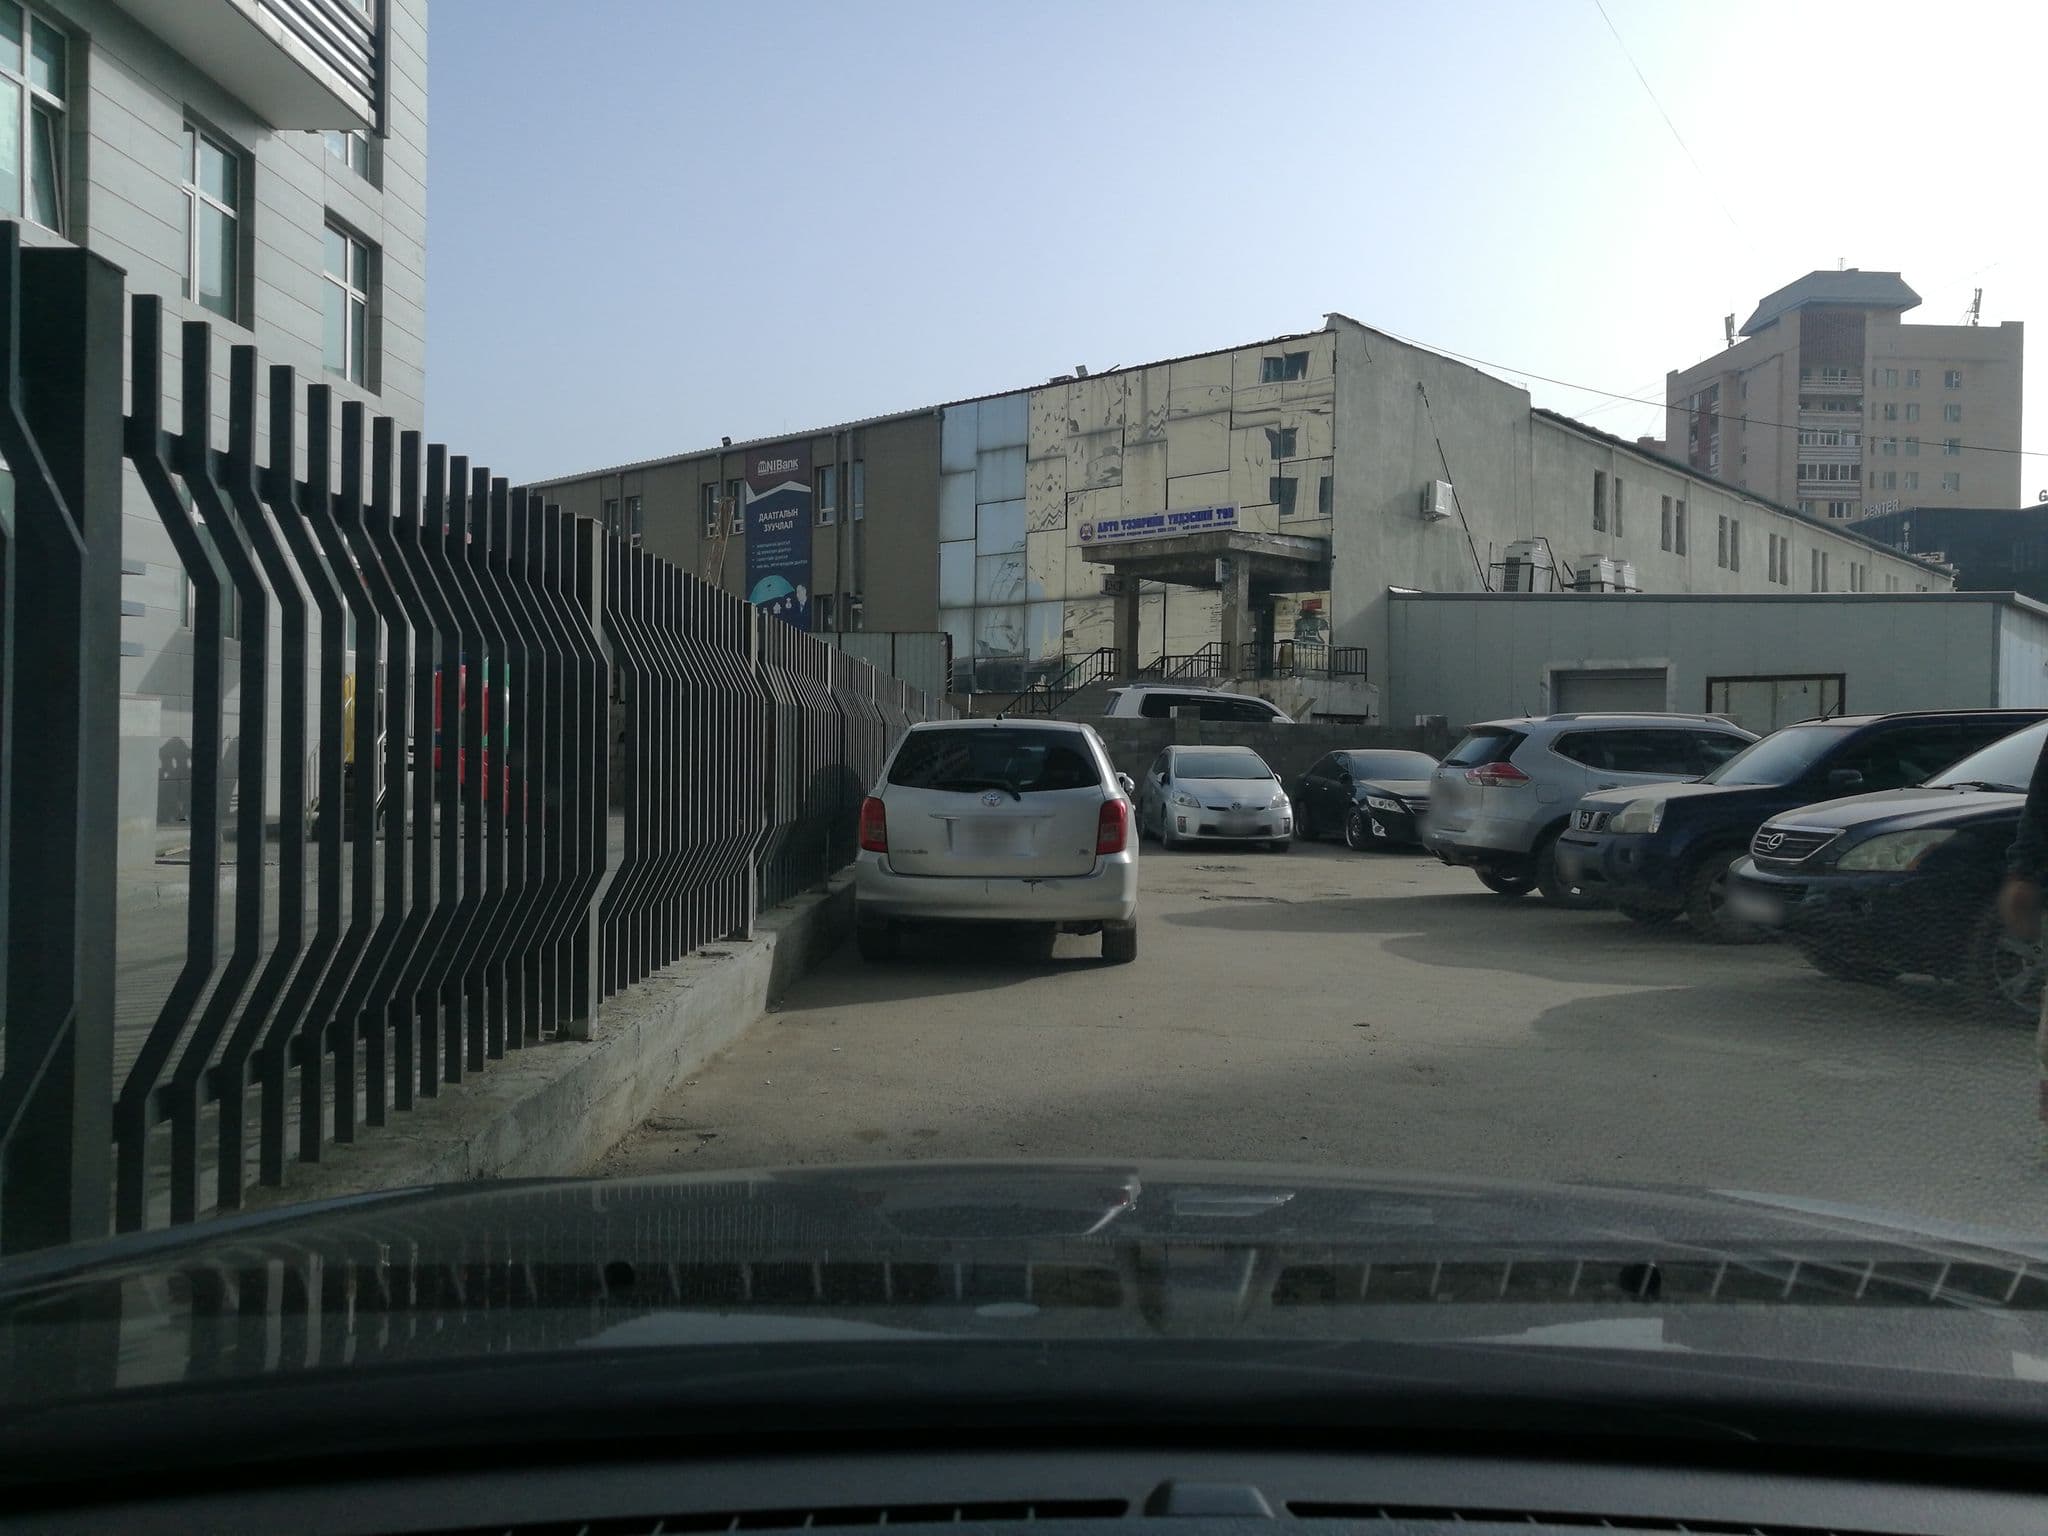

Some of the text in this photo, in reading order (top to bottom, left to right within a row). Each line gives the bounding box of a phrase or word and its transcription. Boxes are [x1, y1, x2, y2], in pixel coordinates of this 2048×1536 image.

[758, 508, 799, 523] ДААТГАЛЫН
[763, 520, 794, 533] ЗУУЧЛАЛ
[1097, 520, 1119, 533] АВТО
